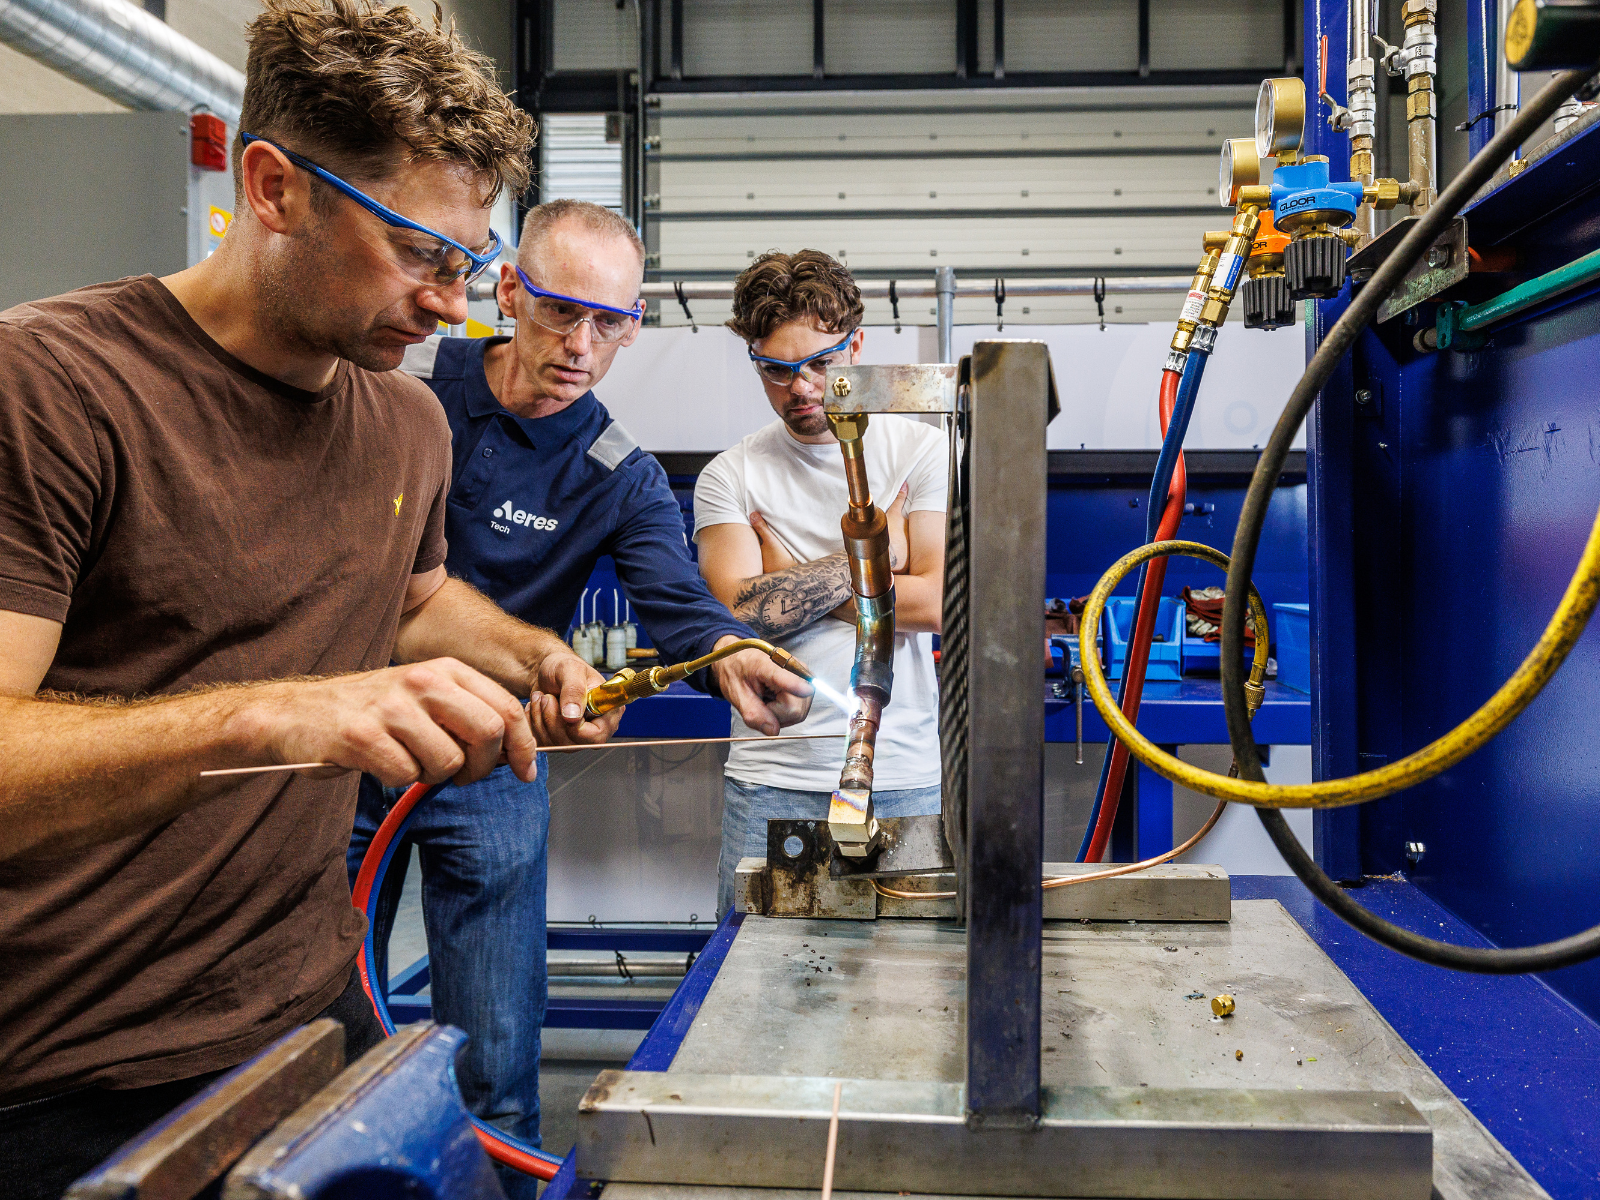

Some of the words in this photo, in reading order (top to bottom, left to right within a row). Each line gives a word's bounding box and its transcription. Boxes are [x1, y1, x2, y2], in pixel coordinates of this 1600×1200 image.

[1280, 196, 1316, 211] GLOOR
[493, 500, 559, 531] Aeres
[490, 520, 511, 534] Tech
